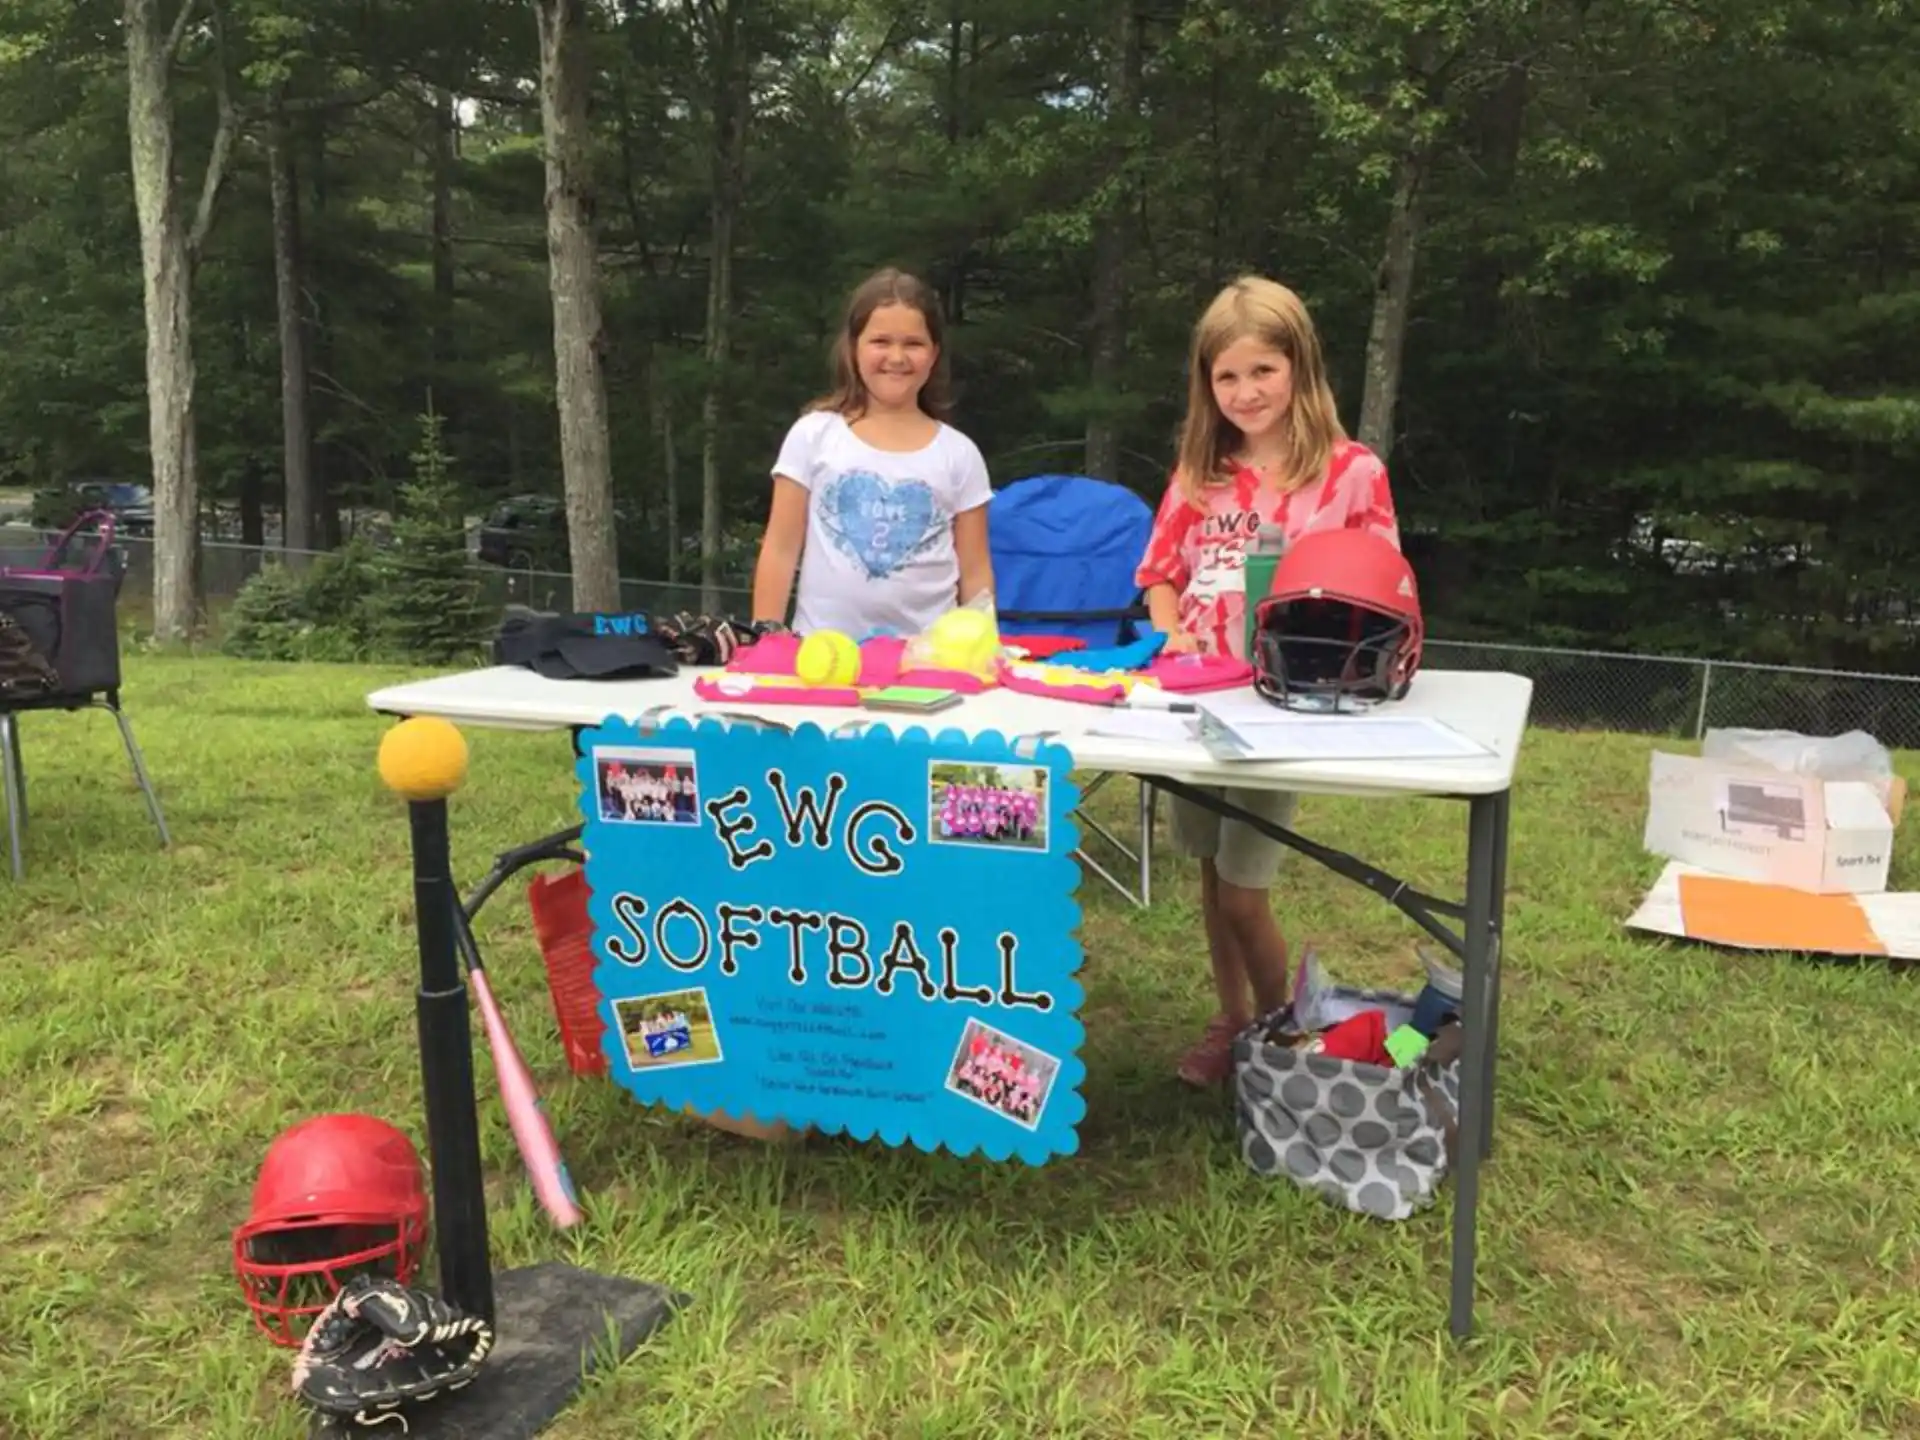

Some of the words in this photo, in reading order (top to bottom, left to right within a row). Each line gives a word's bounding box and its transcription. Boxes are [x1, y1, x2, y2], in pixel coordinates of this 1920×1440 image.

[593, 614, 649, 636] EWG
[706, 767, 917, 876] EWG
[605, 892, 1054, 1012] SOFTBALL
